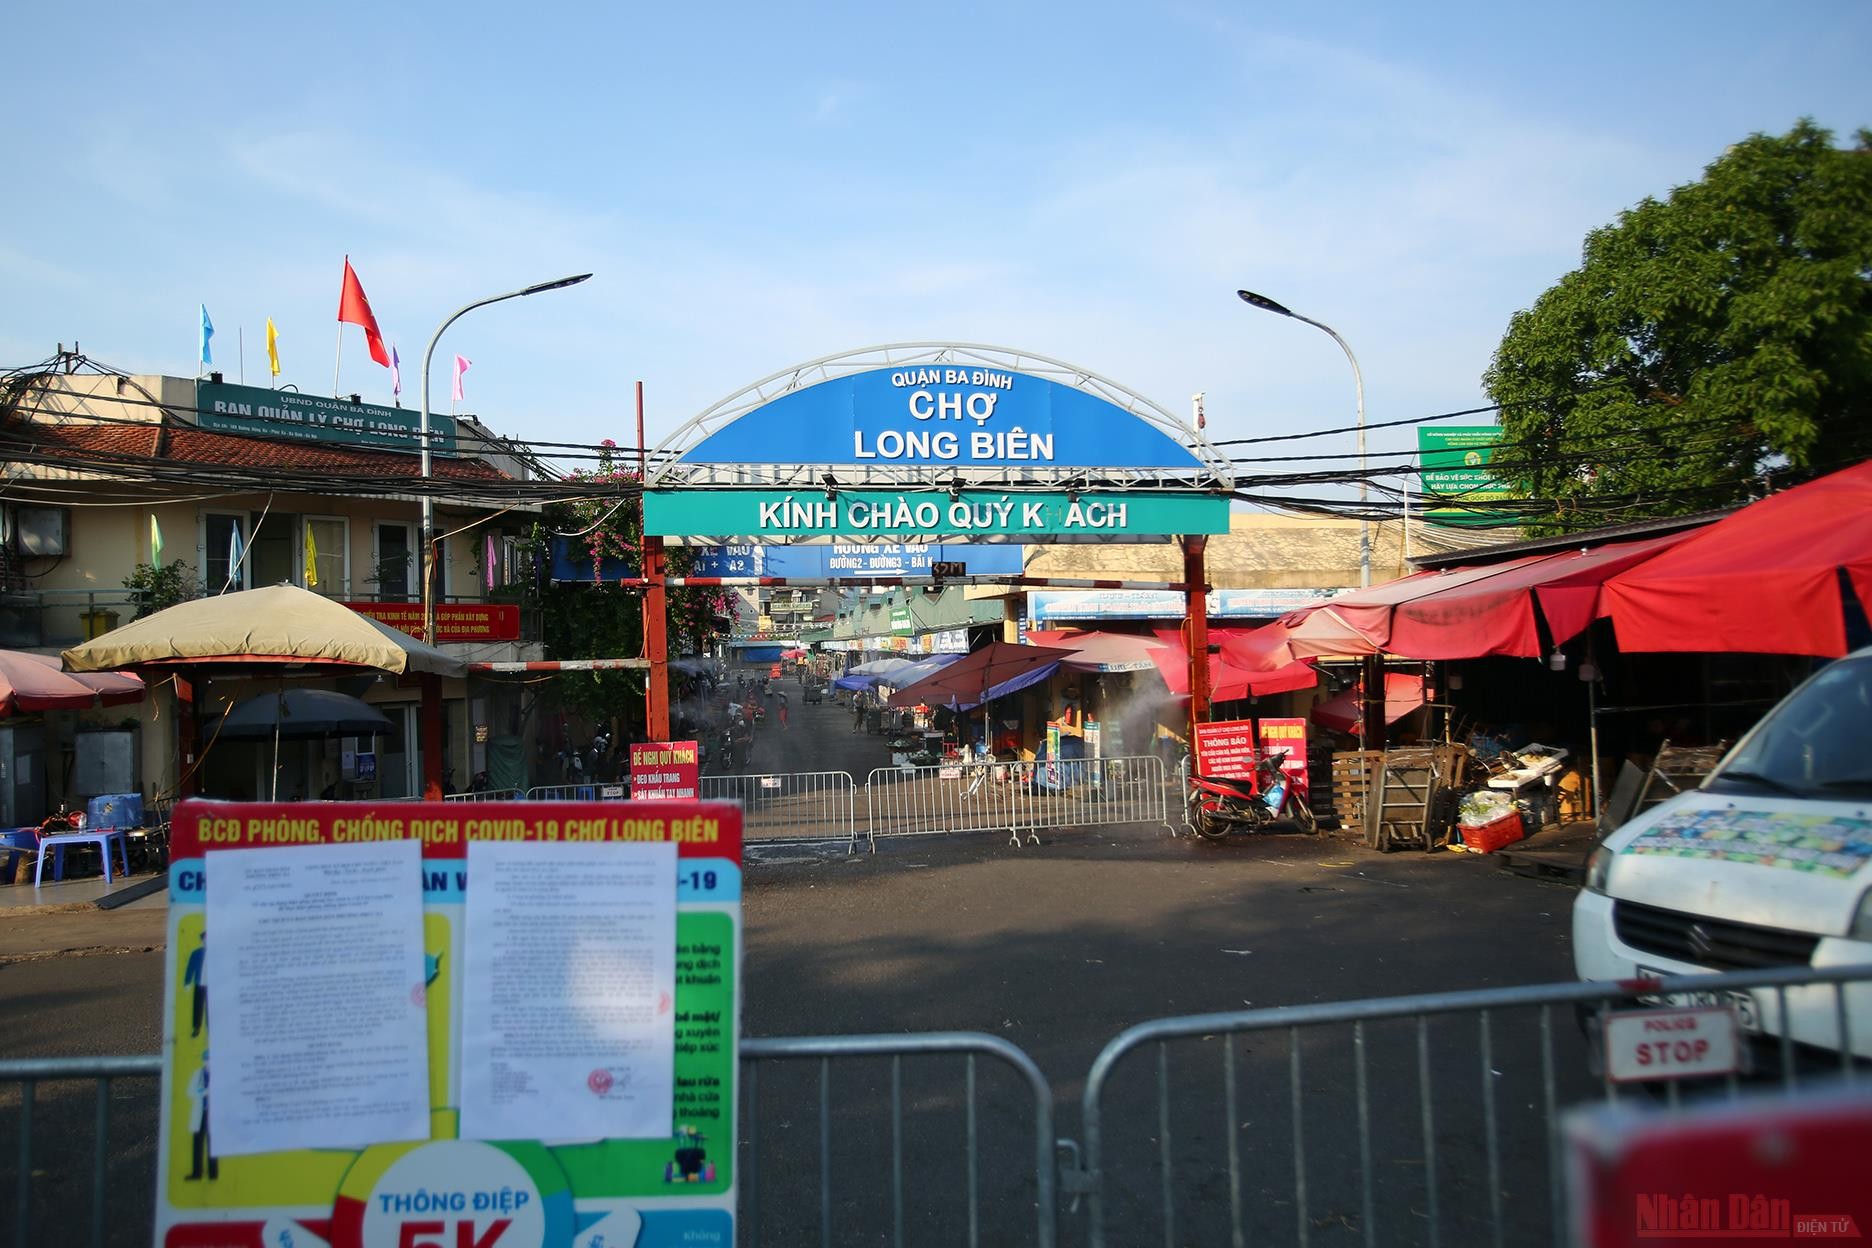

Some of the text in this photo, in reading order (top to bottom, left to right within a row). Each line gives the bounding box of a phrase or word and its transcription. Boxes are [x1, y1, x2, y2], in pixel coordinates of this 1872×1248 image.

[892, 368, 1013, 390] QUẬN BA ĐÌNH
[280, 396, 392, 417] UBND QUẬN BA ĐÌNH
[909, 390, 997, 426] CHỢ
[854, 426, 1054, 460] LONG BIÊN
[759, 495, 1127, 530] KÍNH CHÀO QUÝ KÁCH
[729, 560, 744, 571] A2
[911, 554, 925, 568] BÃI
[1203, 736, 1247, 747] THÔNG BÁO
[673, 747, 695, 765] KHÁCH
[663, 772, 680, 783] TRANG
[199, 818, 241, 842] BCĐ
[247, 814, 326, 844] PHÒNG,
[332, 811, 404, 842] CHỐNG
[411, 818, 459, 848] DỊCH
[465, 818, 559, 842] COVID-19
[612, 818, 665, 842] LONG
[671, 814, 719, 843] BIÊN
[1643, 1017, 1697, 1034] POLICE
[1635, 1039, 1711, 1066] STOP
[378, 1187, 530, 1215] THÔNG ĐIỆP
